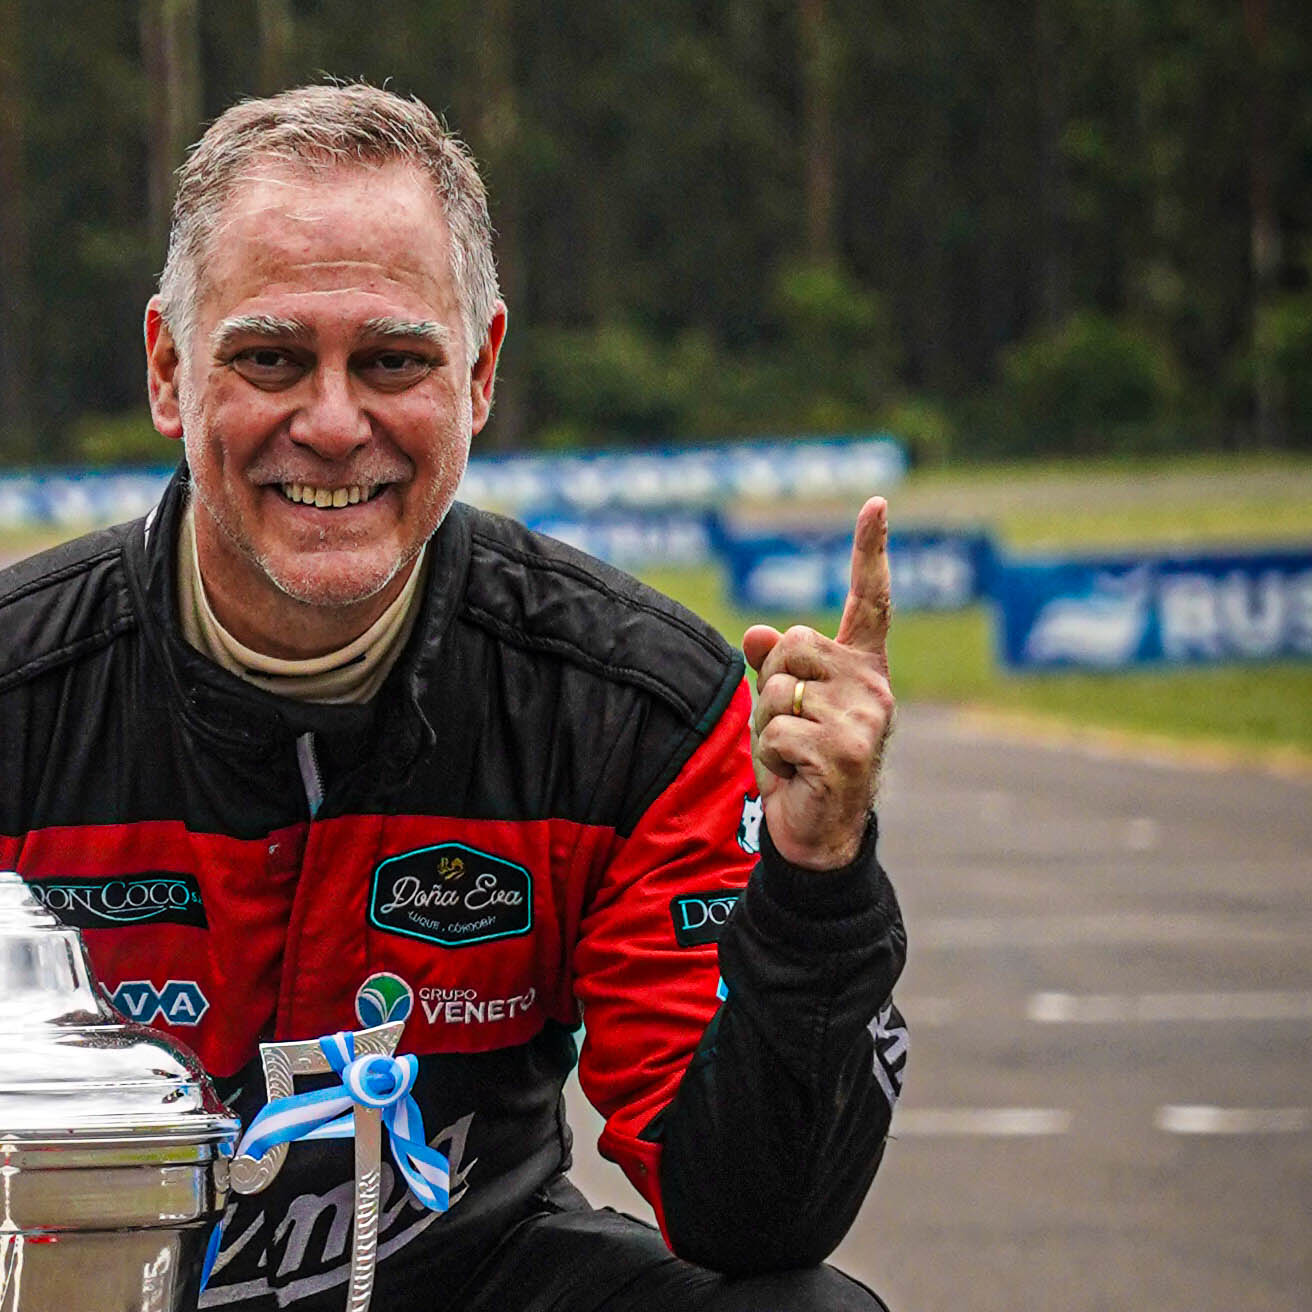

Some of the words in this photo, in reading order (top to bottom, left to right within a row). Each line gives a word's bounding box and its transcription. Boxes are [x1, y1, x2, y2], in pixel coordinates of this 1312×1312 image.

[380, 876, 459, 914] Doña
[464, 873, 523, 910] Eva
[677, 899, 737, 931] DO
[419, 987, 477, 1001] GRUPO
[420, 987, 536, 1025] VENETO
